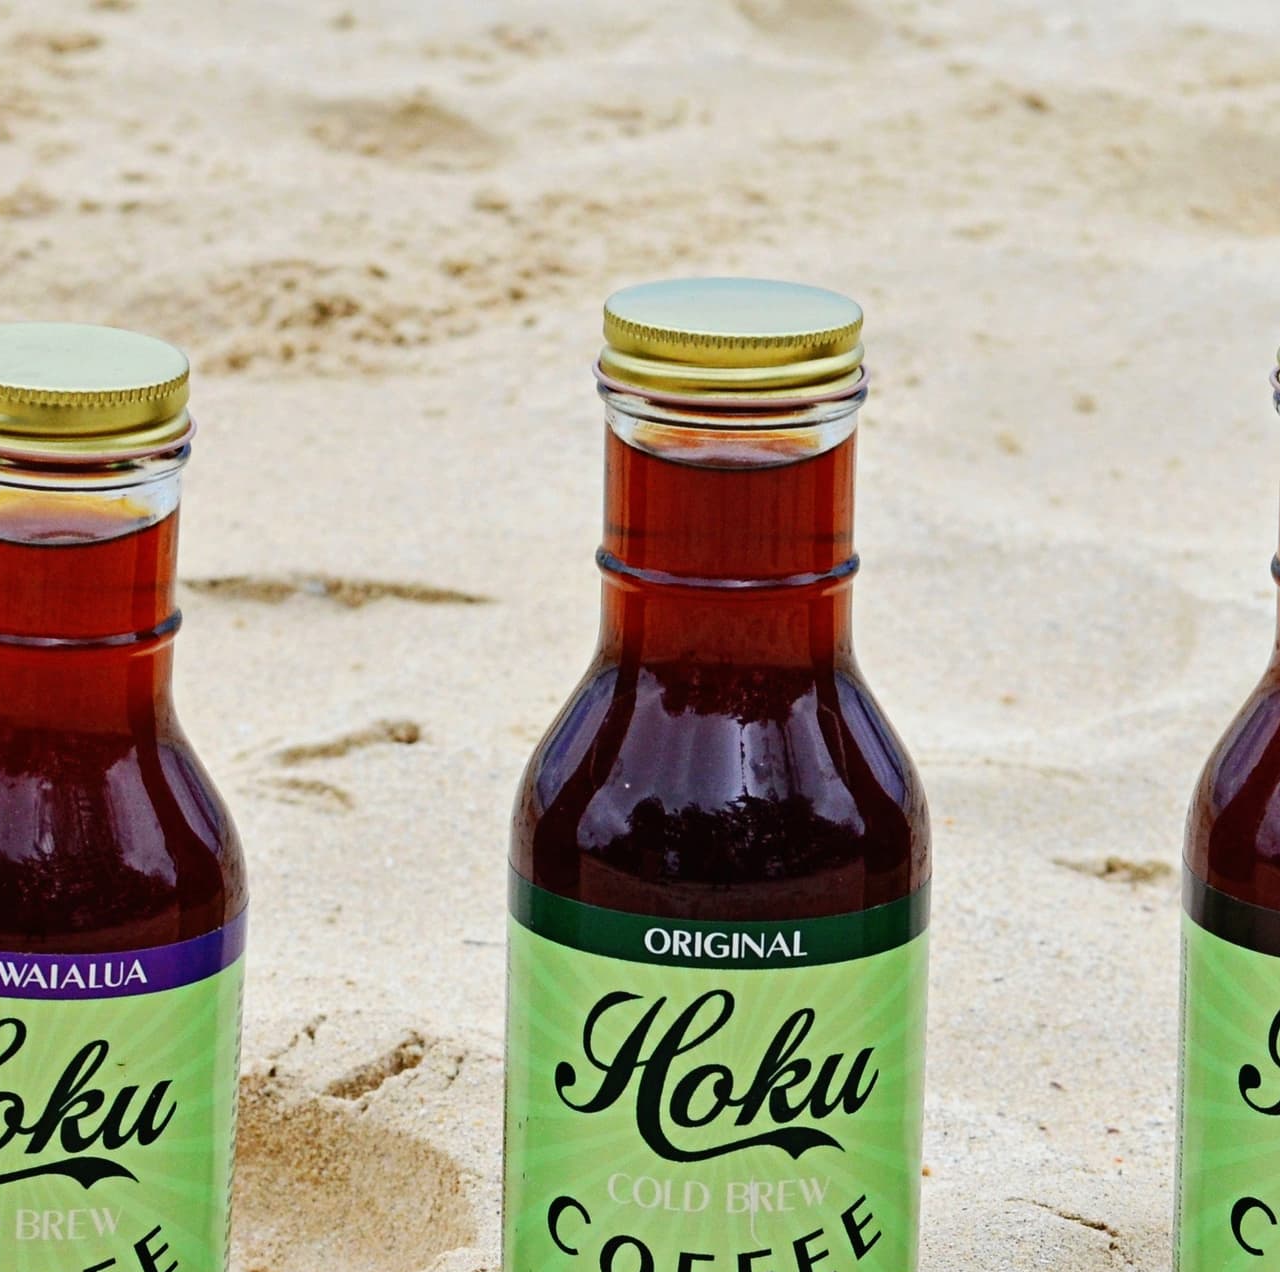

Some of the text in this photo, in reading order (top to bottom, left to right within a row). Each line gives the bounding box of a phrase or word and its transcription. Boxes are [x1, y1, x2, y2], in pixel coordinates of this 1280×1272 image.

[644, 927, 807, 959] ORIGINAL
[554, 989, 879, 1162] Hoku
[608, 1172, 831, 1213] COLD BREW
[16, 1207, 122, 1240] BREW
